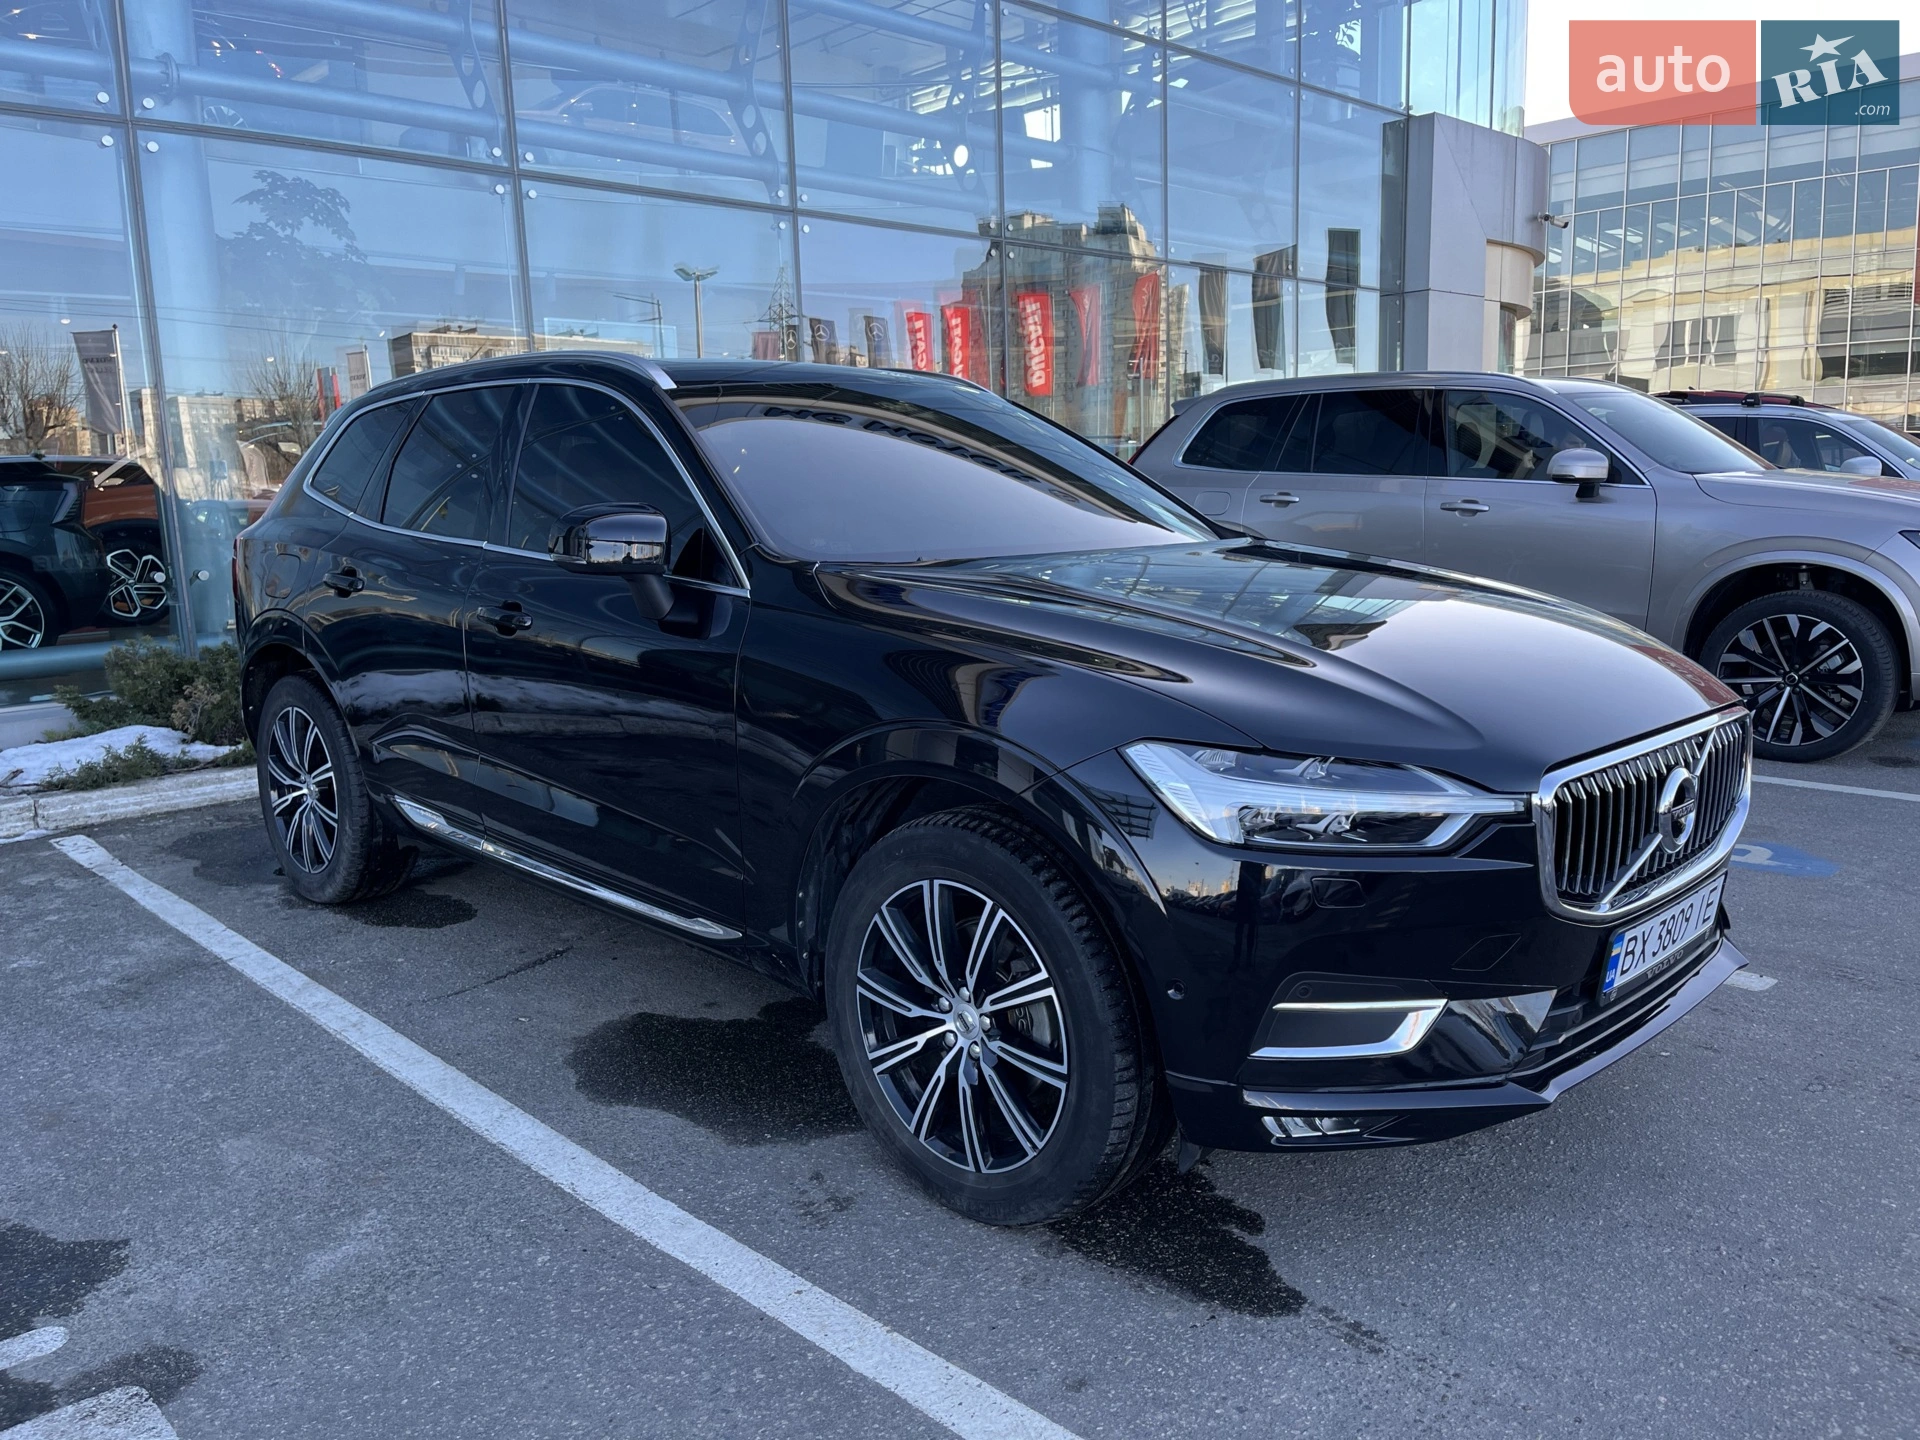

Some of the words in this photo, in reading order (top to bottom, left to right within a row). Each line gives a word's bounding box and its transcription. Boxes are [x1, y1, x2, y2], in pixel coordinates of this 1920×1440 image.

[1620, 925, 1654, 976] BX
[1652, 902, 1693, 958] 3809
[1695, 886, 1717, 930] IE
[1646, 949, 1684, 979] VOLVO
